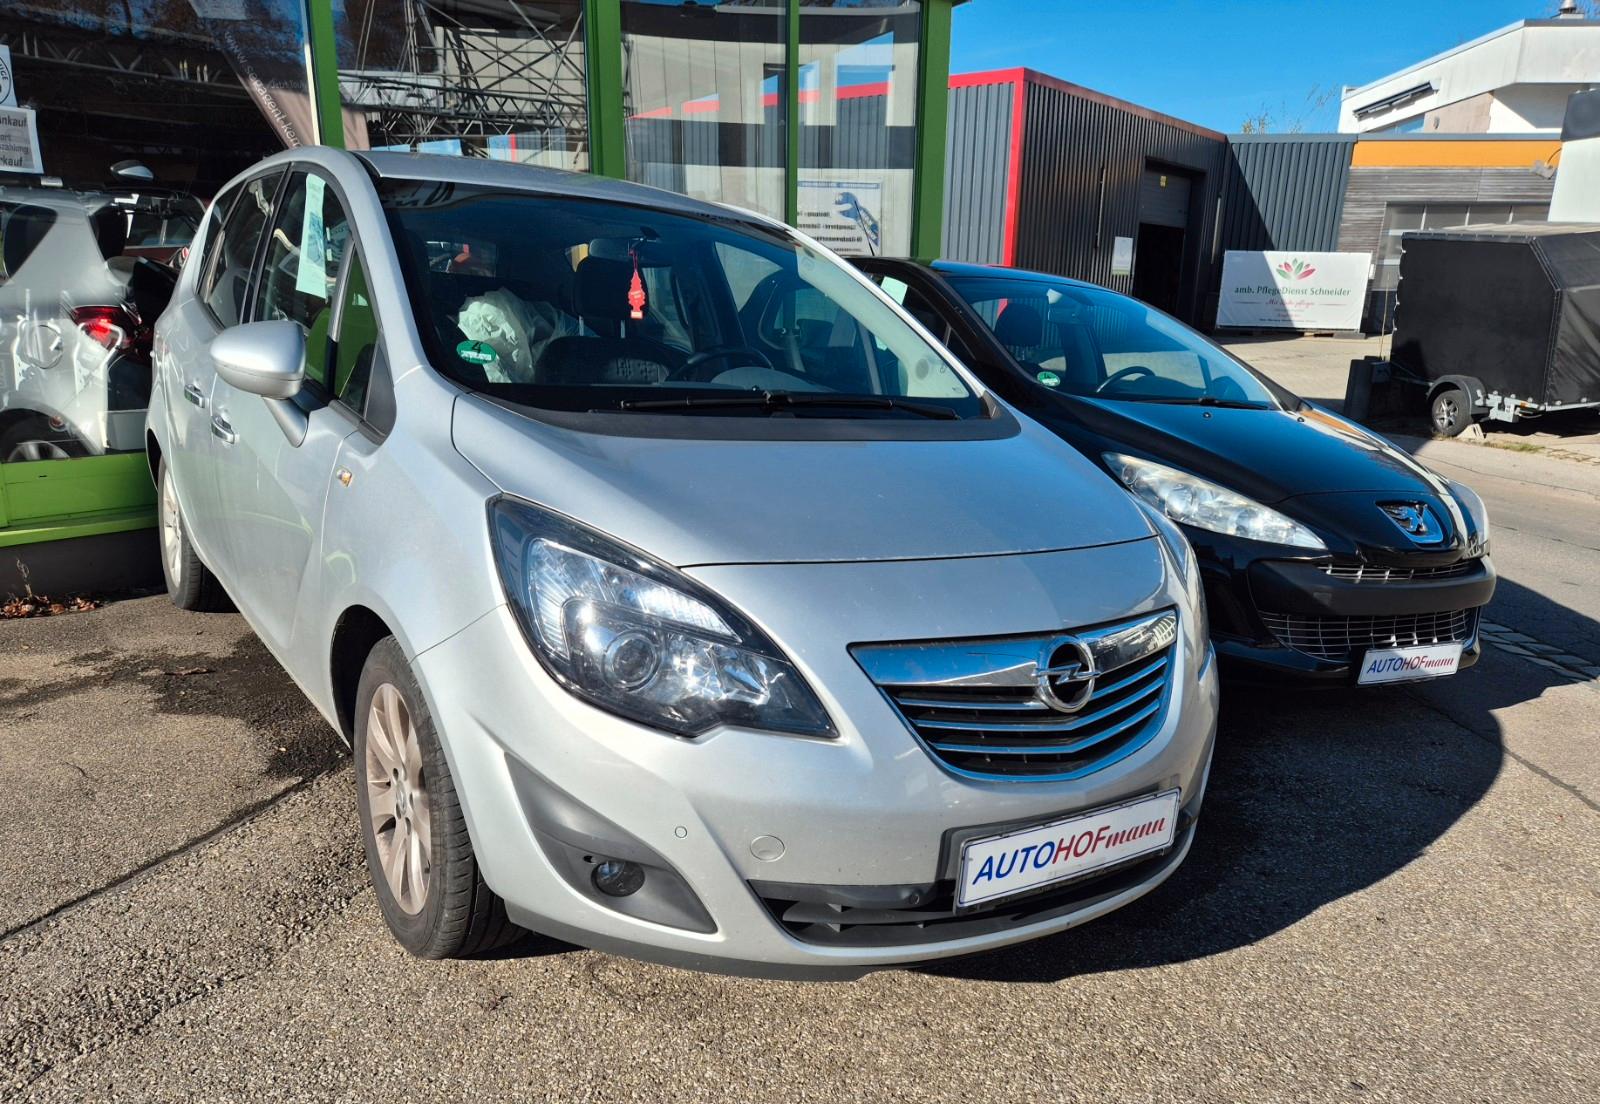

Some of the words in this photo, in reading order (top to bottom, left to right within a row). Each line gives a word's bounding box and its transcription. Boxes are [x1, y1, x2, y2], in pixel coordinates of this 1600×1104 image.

[1234, 285, 1255, 294] amb.
[1257, 286, 1307, 297] PflegeDienst
[1309, 287, 1351, 297] Schneider
[1367, 655, 1454, 674] AUTOHOFmann
[972, 817, 1166, 886] AUTOHOFmann
